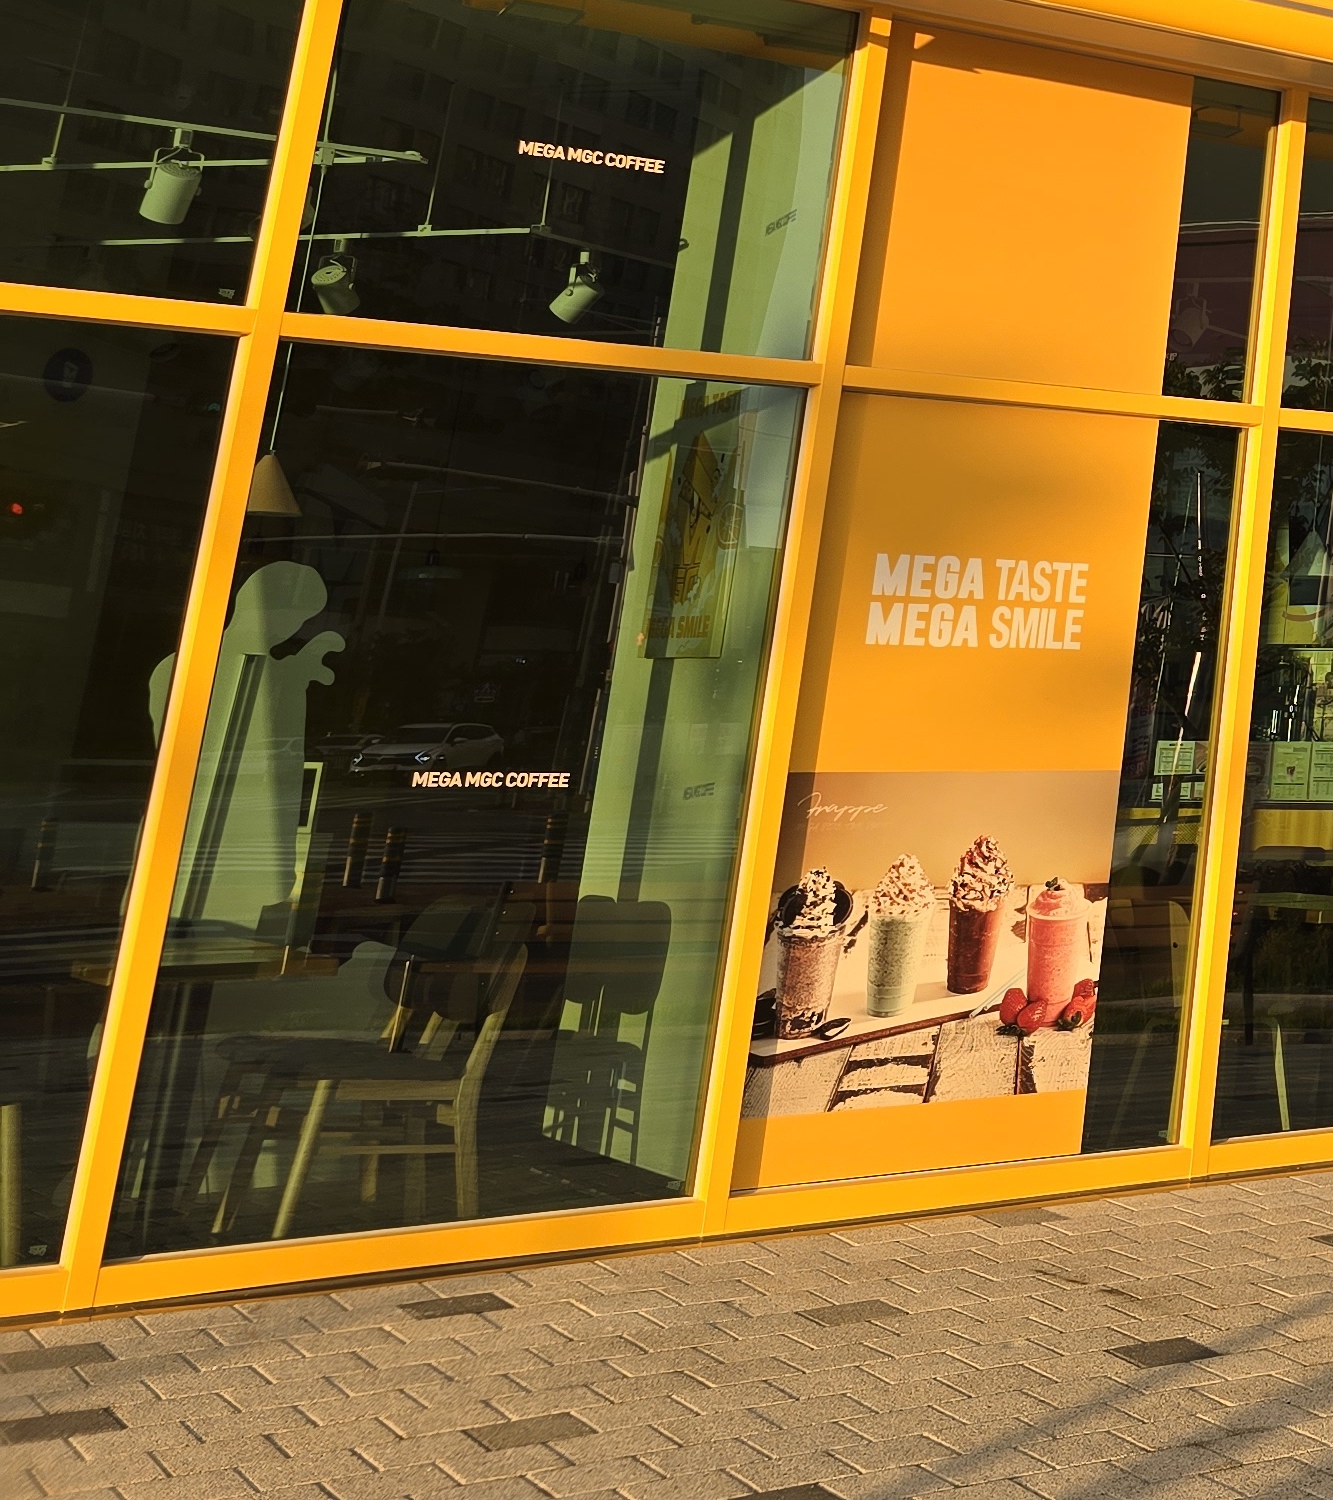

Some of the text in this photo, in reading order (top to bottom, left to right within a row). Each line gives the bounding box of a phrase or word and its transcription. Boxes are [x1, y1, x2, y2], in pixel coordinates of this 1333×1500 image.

[518, 140, 666, 174] MEGA MGC COFFEE
[872, 553, 1089, 604] MEGA TASTE
[865, 601, 1085, 650] MEGA SMILE
[411, 771, 571, 788] MEGA MGC COFFEE
